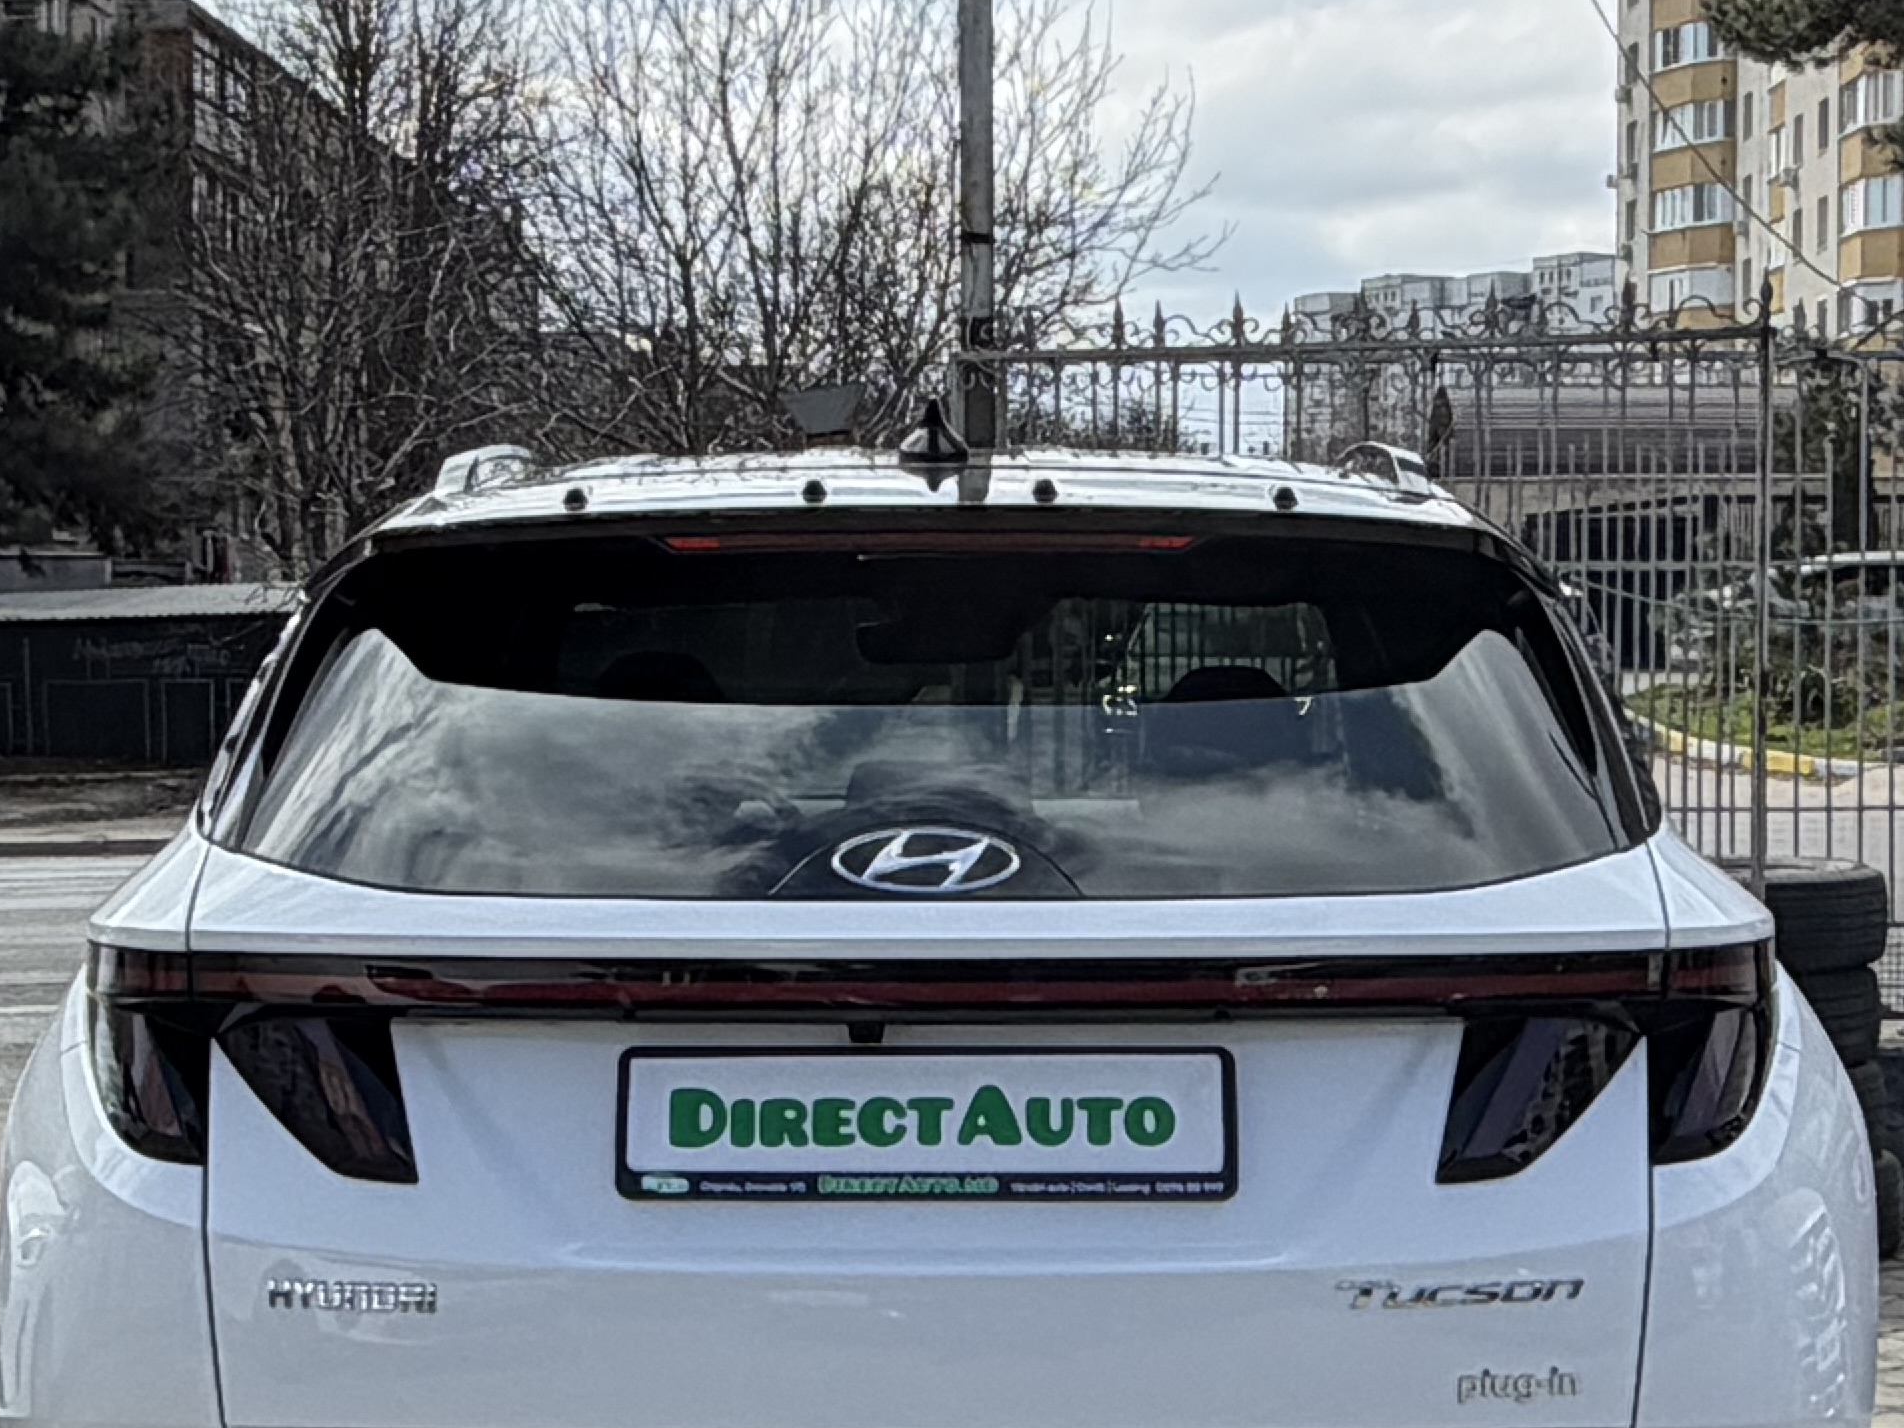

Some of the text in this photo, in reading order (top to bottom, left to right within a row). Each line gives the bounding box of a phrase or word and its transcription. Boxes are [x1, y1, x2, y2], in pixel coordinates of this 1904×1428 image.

[669, 1084, 1176, 1148] DIRECTAUTO
[266, 1279, 438, 1314] HYUNDAI
[1457, 1365, 1579, 1405] plug-in
